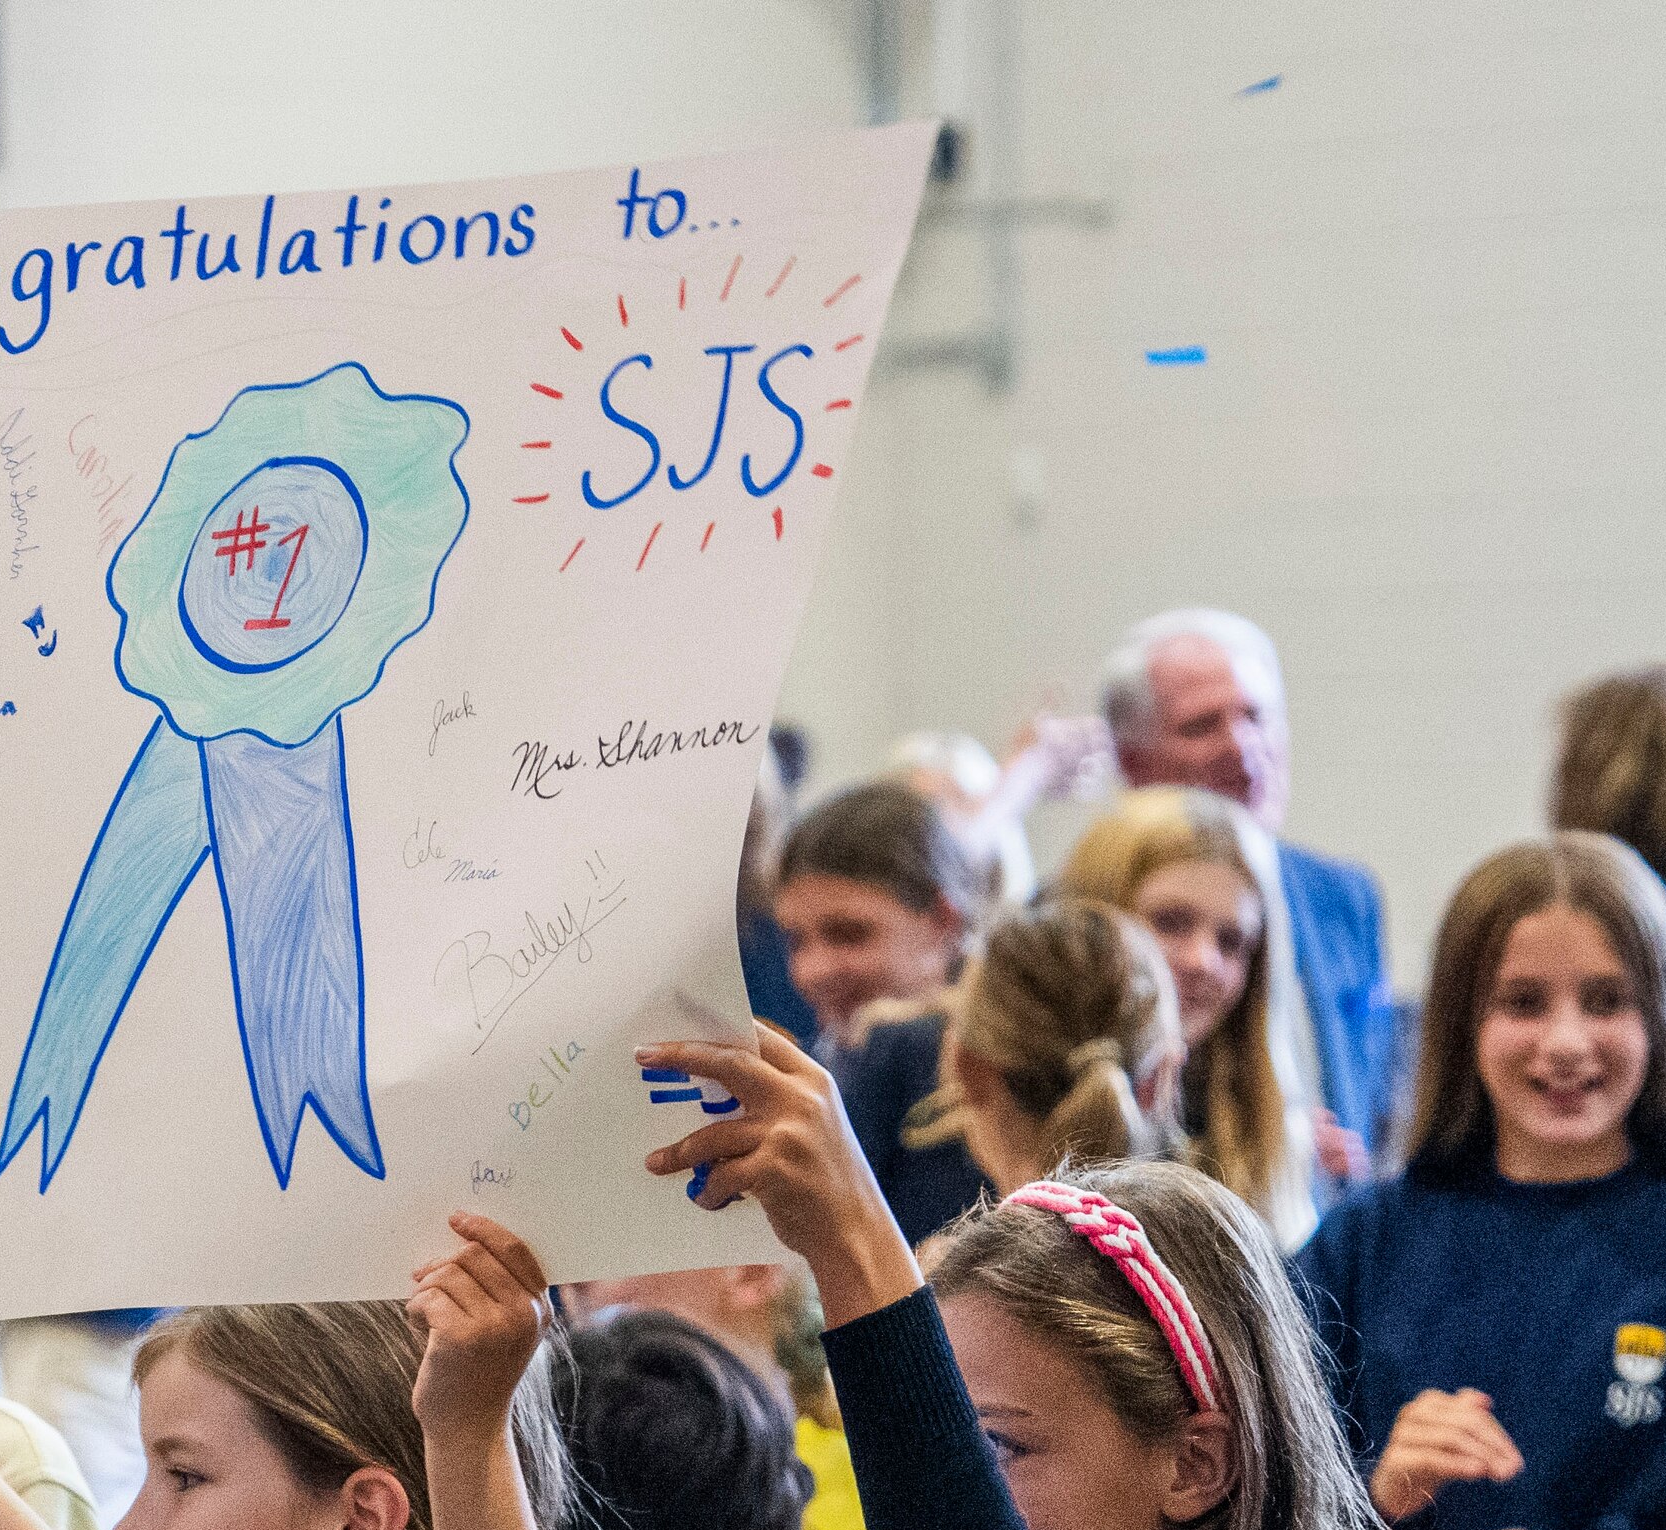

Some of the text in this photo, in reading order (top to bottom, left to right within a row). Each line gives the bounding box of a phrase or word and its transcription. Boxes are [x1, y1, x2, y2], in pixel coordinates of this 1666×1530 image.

[617, 168, 741, 240] to...
[581, 344, 814, 510] SJS
[211, 503, 310, 631] #1
[511, 741, 587, 800] Mrs.
[508, 1040, 585, 1132] Bella
